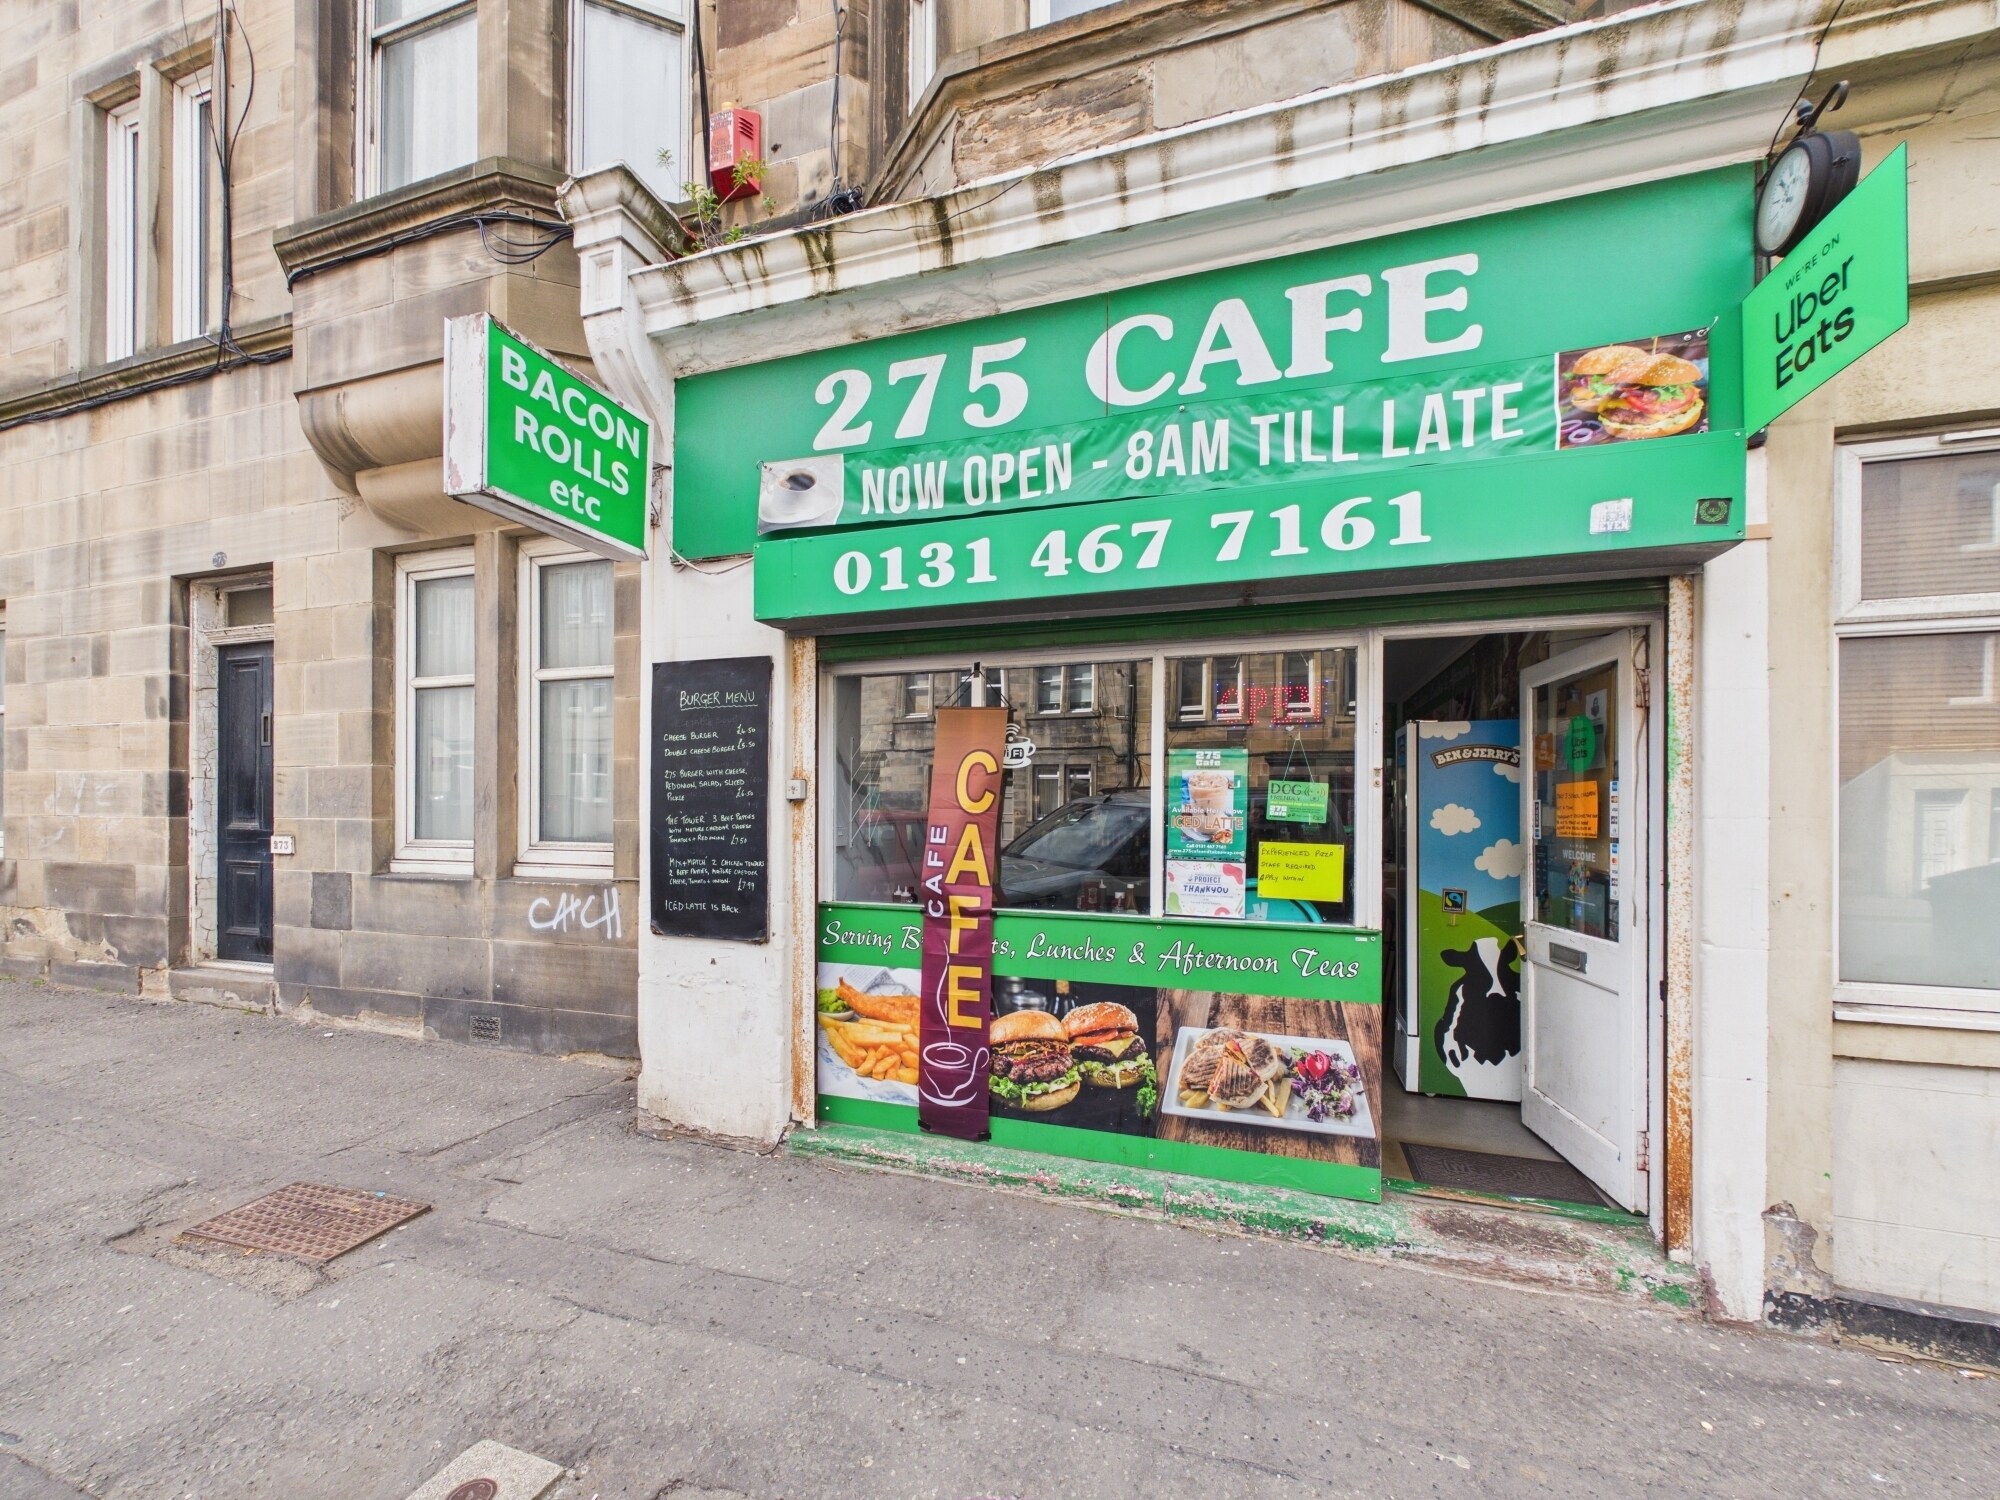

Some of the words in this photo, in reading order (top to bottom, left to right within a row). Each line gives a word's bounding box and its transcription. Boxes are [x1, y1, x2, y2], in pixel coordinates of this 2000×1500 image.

[1784, 253, 1818, 291] WE'RE
[1821, 233, 1841, 257] ON
[1775, 254, 1854, 344] Uber
[812, 337, 1029, 451] 275
[1085, 252, 1484, 407] CAFE
[1776, 306, 1855, 391] Eats
[500, 344, 641, 460] BACON
[514, 405, 630, 497] ROLLS
[860, 460, 948, 515] NOW
[962, 442, 1072, 507] OPEN
[1125, 418, 1230, 480] 8AM
[1250, 405, 1359, 467] TILL
[1382, 382, 1525, 460] LATE
[549, 478, 602, 523] etc
[833, 537, 998, 595] 0131
[1029, 519, 1173, 577] 467
[1210, 490, 1432, 562] 7161
[680, 690, 720, 708] BURGER
[725, 689, 755, 704] MENU
[1220, 683, 1325, 724] OPEN
[663, 733, 687, 741] CHEESE
[690, 731, 719, 740] BURGER
[664, 748, 687, 757] DOUBLE
[737, 738, 756, 750] £5.50
[1195, 750, 1221, 760] 275
[664, 769, 676, 780] 275
[680, 768, 704, 778] BURGER
[706, 768, 724, 776] WITH
[724, 778, 745, 786] SLICED
[1270, 782, 1302, 796] DOG
[665, 814, 679, 825] THE
[712, 814, 718, 823] 3
[1170, 815, 1201, 829] ICED
[1204, 816, 1244, 831] LATTE
[273, 840, 289, 850] 273
[1261, 848, 1311, 857] EXPERIENCED
[1314, 849, 1334, 858] PIZZA
[711, 858, 718, 866] 2
[1562, 848, 1597, 863] WELCOME
[927, 824, 949, 919] CAFE
[1194, 876, 1222, 884] PROJECT
[1259, 873, 1279, 883] APPLY
[945, 750, 1000, 1030] CAFE
[664, 899, 684, 912] ICED
[685, 902, 707, 911] LATTE
[710, 903, 719, 912] IS
[822, 919, 893, 954] Serving
[1026, 931, 1117, 963] Lunches
[1128, 940, 1147, 965] &
[1157, 938, 1280, 976] Afternoon
[1290, 947, 1361, 979] Teas
